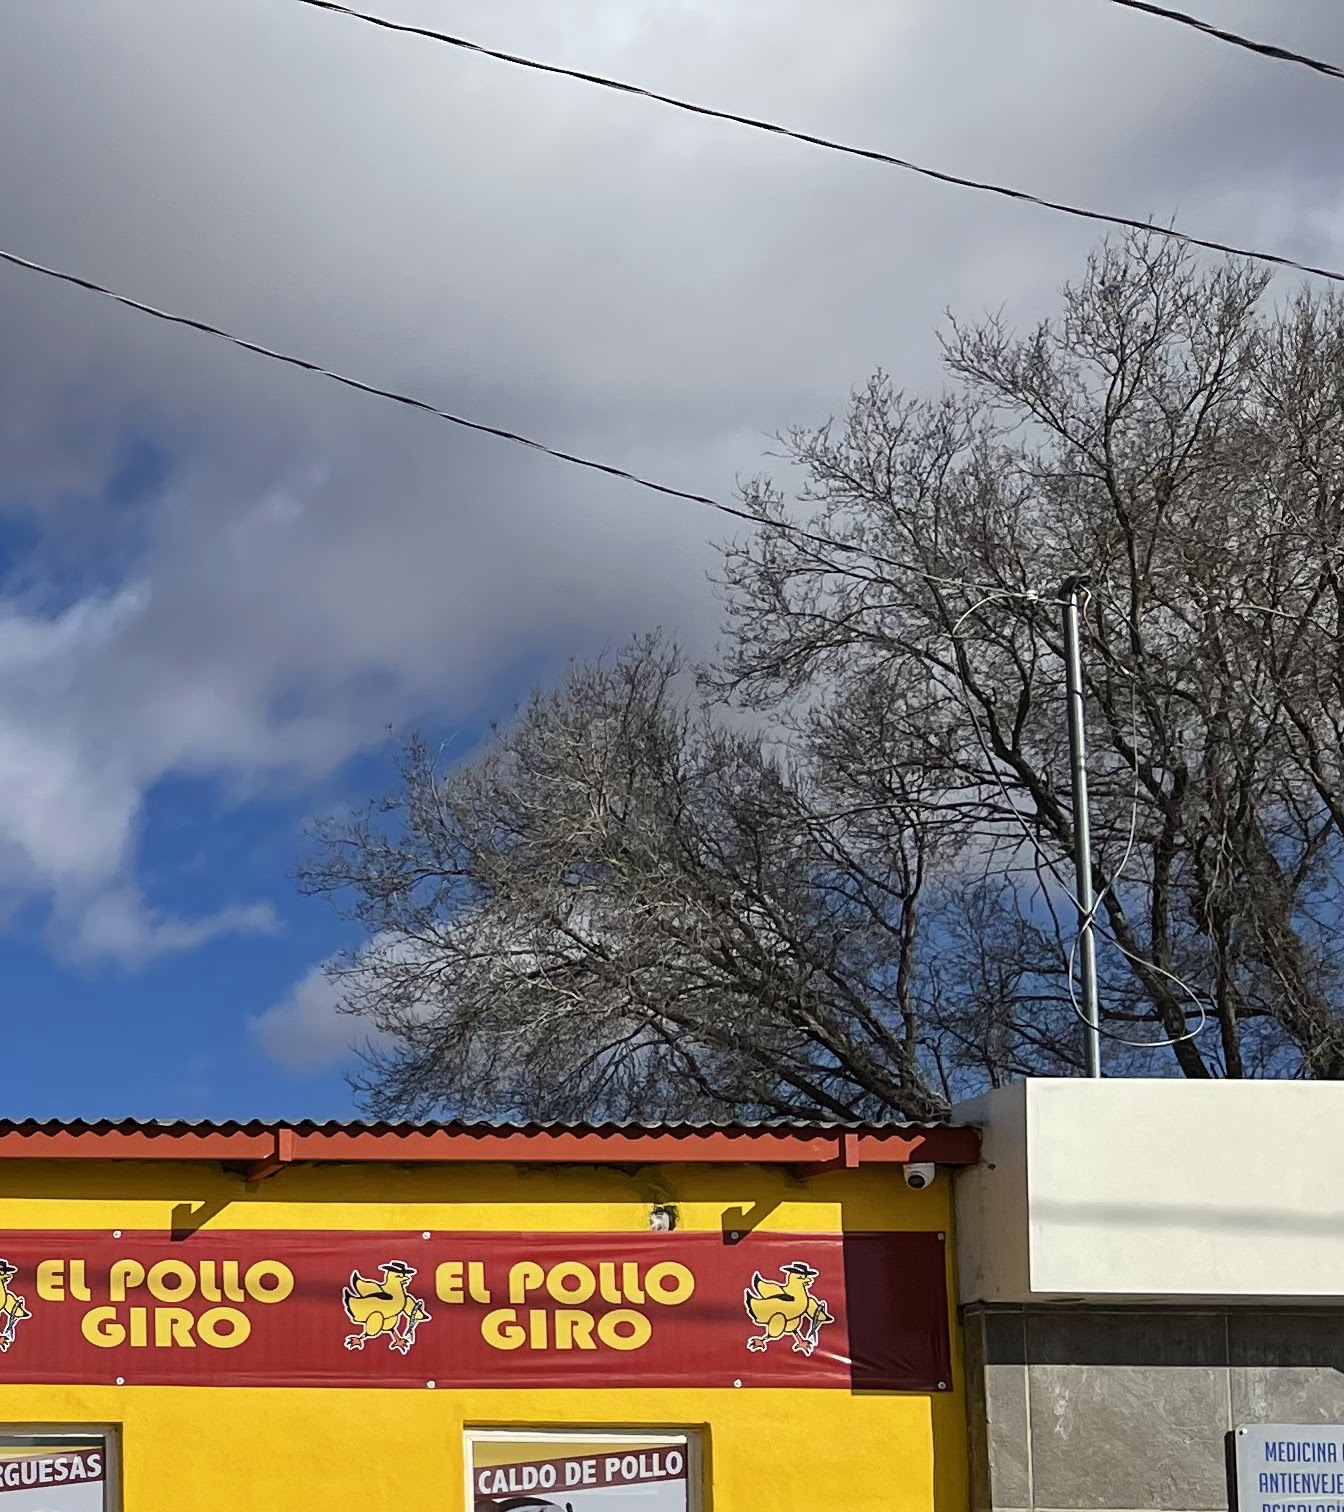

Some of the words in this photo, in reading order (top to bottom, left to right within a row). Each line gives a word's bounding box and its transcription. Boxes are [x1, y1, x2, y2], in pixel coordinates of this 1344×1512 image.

[37, 1260, 90, 1301] EL
[110, 1260, 294, 1303] POLLO
[436, 1262, 490, 1303] EL
[509, 1262, 694, 1305] POLLO
[82, 1306, 250, 1348] GIRO
[482, 1309, 651, 1350] GIRO
[479, 1464, 556, 1494] CALDO
[566, 1460, 596, 1485] DE
[605, 1452, 682, 1481] POLLO
[1265, 1442, 1336, 1462] MEDICINA
